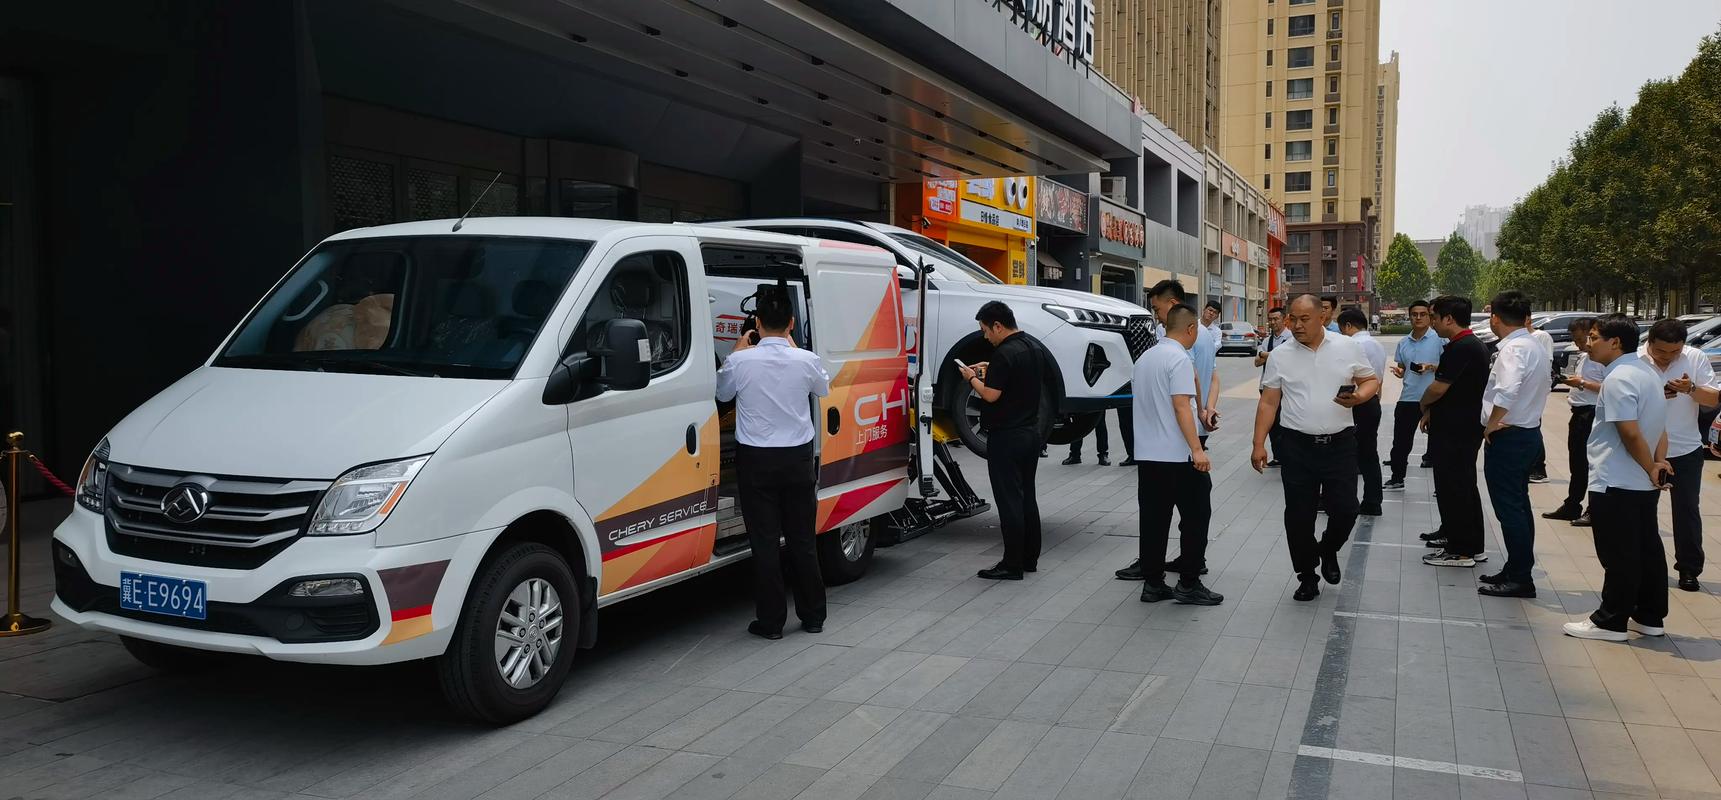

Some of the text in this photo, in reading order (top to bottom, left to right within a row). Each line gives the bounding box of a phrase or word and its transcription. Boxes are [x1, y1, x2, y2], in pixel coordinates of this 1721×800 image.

[855, 424, 888, 445] 上门服务
[608, 500, 708, 541] CHERY SERVICE
